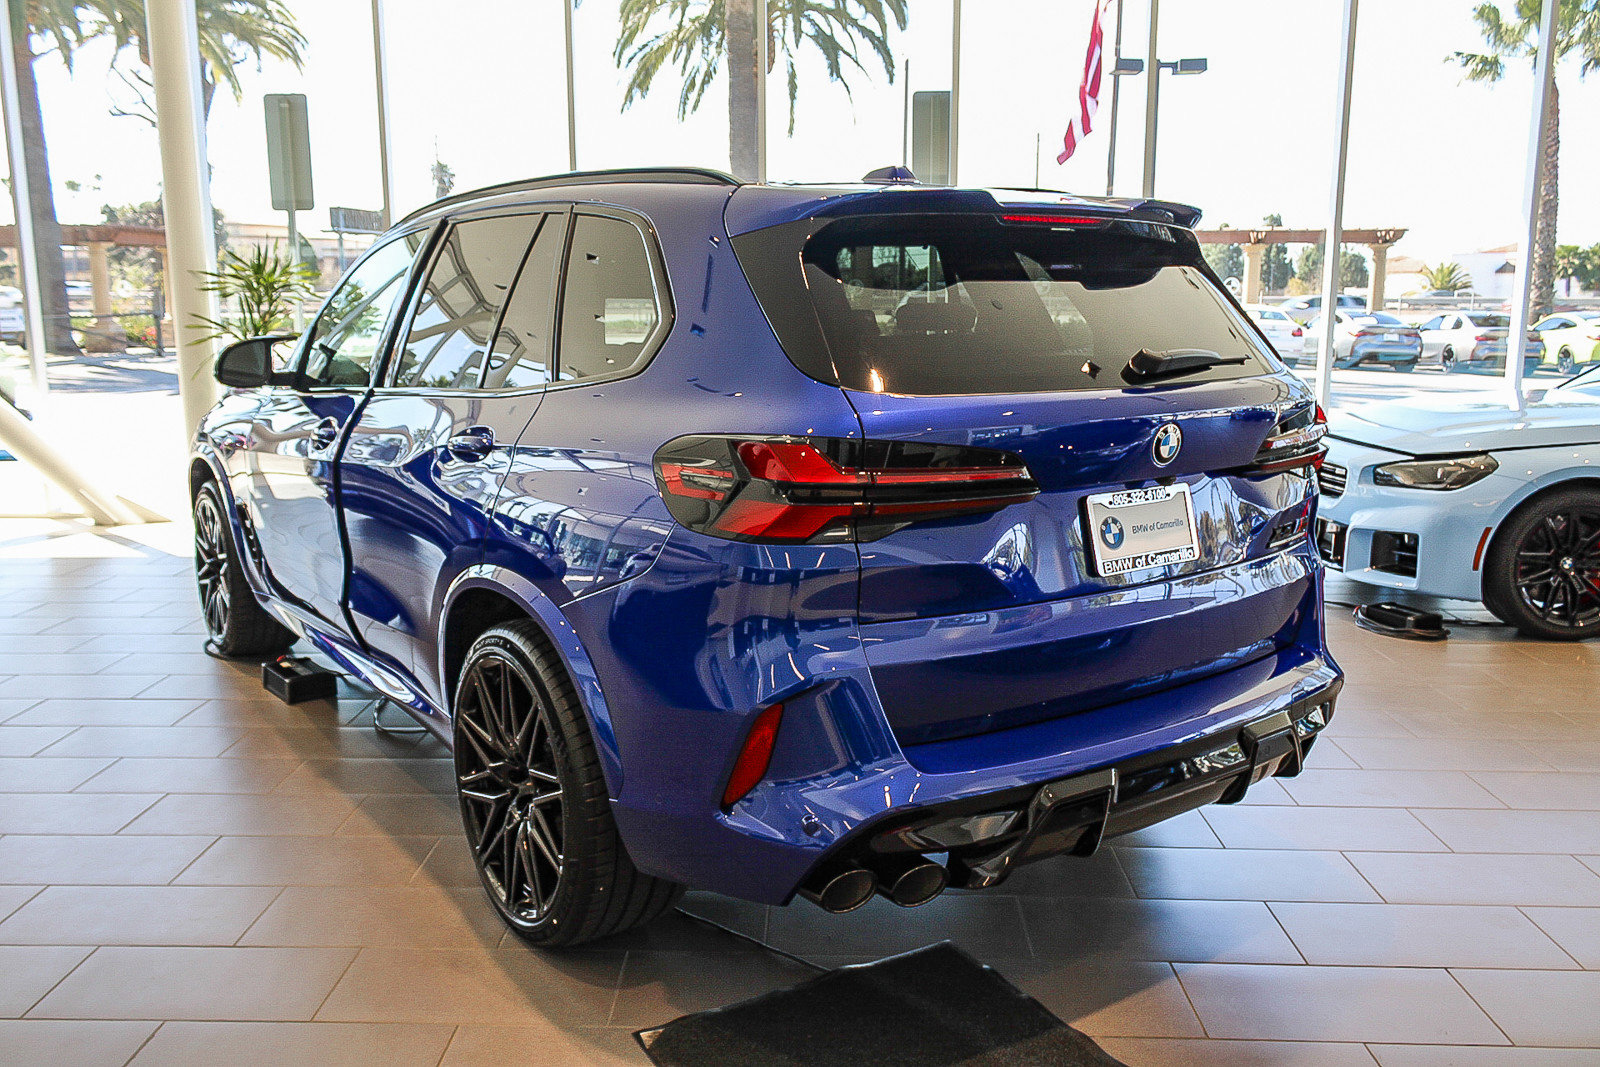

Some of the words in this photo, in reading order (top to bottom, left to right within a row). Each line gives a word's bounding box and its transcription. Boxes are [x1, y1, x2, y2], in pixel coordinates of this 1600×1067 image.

[1132, 524, 1148, 534] BMW
[1149, 522, 1156, 531] of
[1156, 518, 1184, 530] Camarillo
[1104, 558, 1133, 574] BMW
[1135, 555, 1146, 568] of
[1148, 549, 1194, 564] Camarillo
